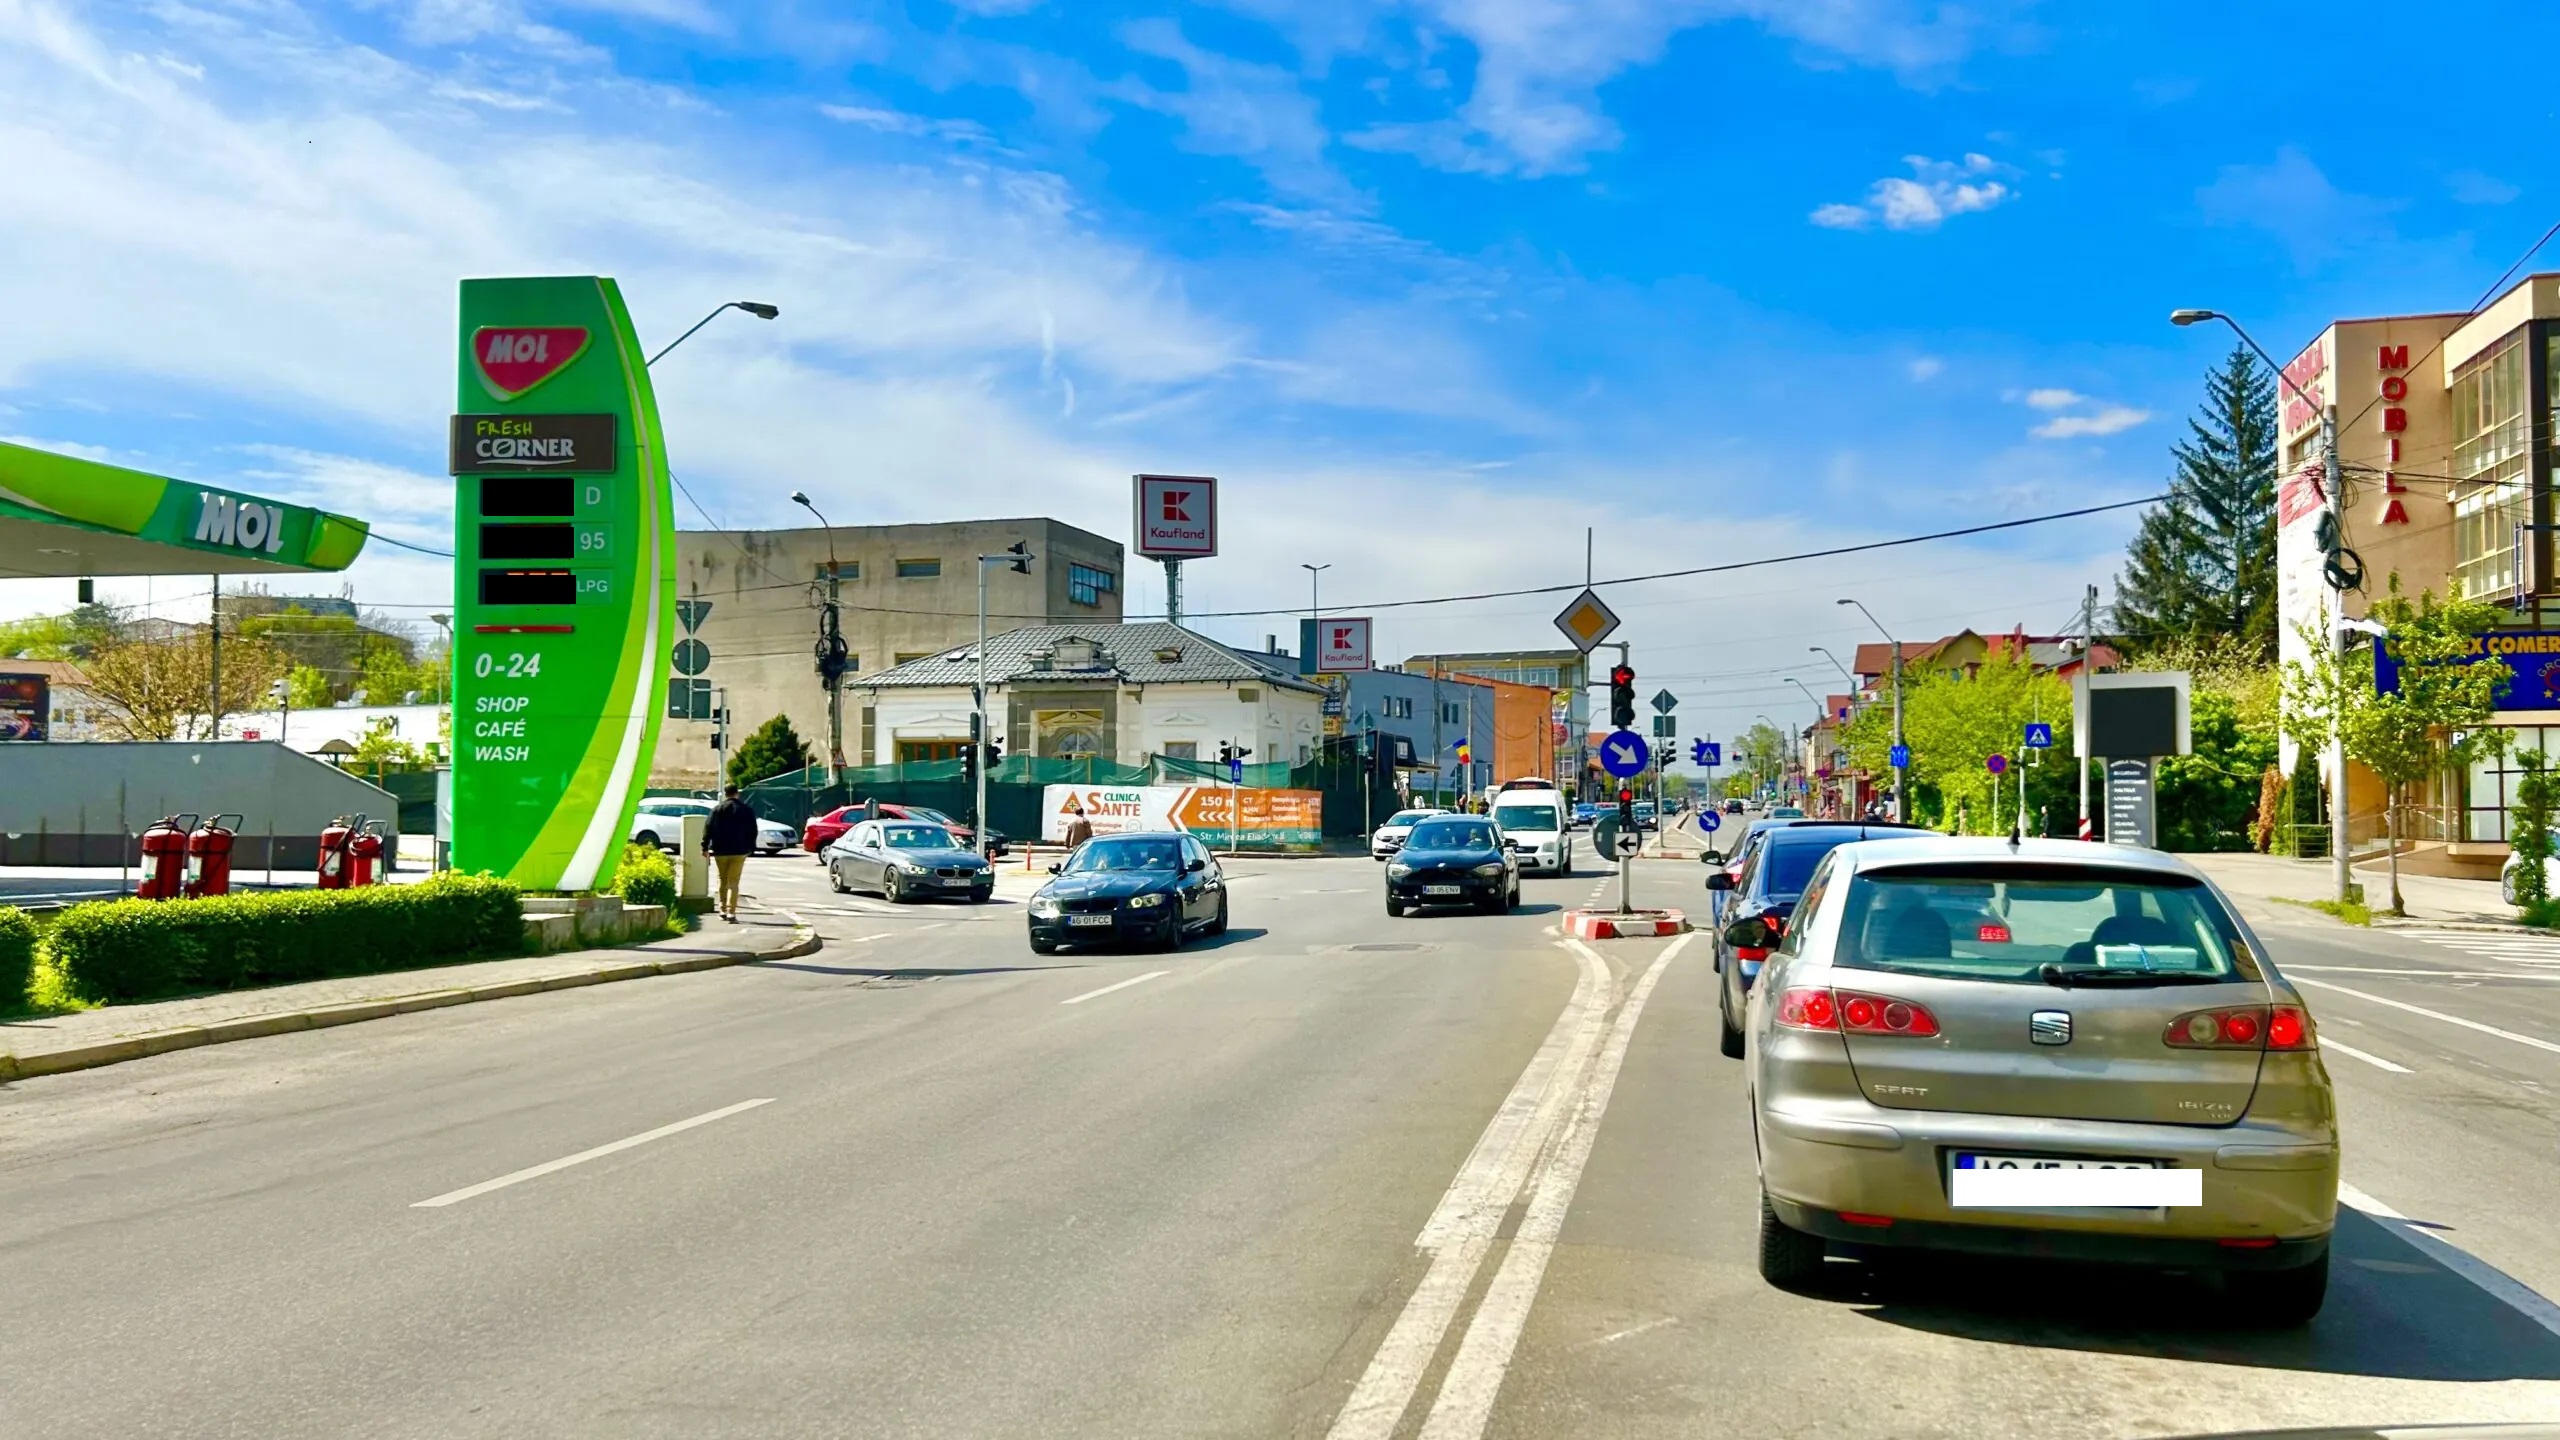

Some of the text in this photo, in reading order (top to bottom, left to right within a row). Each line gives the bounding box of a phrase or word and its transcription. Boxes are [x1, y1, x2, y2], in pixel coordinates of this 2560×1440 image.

[485, 334, 549, 364] MOL
[2377, 345, 2409, 526] MOBILA
[476, 438, 575, 458] CORNER
[585, 486, 601, 505] D
[195, 492, 284, 553] MOL
[580, 532, 605, 550] 95
[1151, 528, 1205, 539] Kaufland
[576, 580, 608, 593] LPG
[1325, 654, 1363, 662] Kaufland
[475, 697, 530, 713] SHOP
[475, 718, 527, 738] CAFÉ
[475, 746, 530, 762] WASH
[1104, 792, 1141, 802] CLINICA
[1200, 796, 1223, 807] 150
[1200, 831, 1213, 841] Str.
[1873, 1084, 1929, 1096] SEAT
